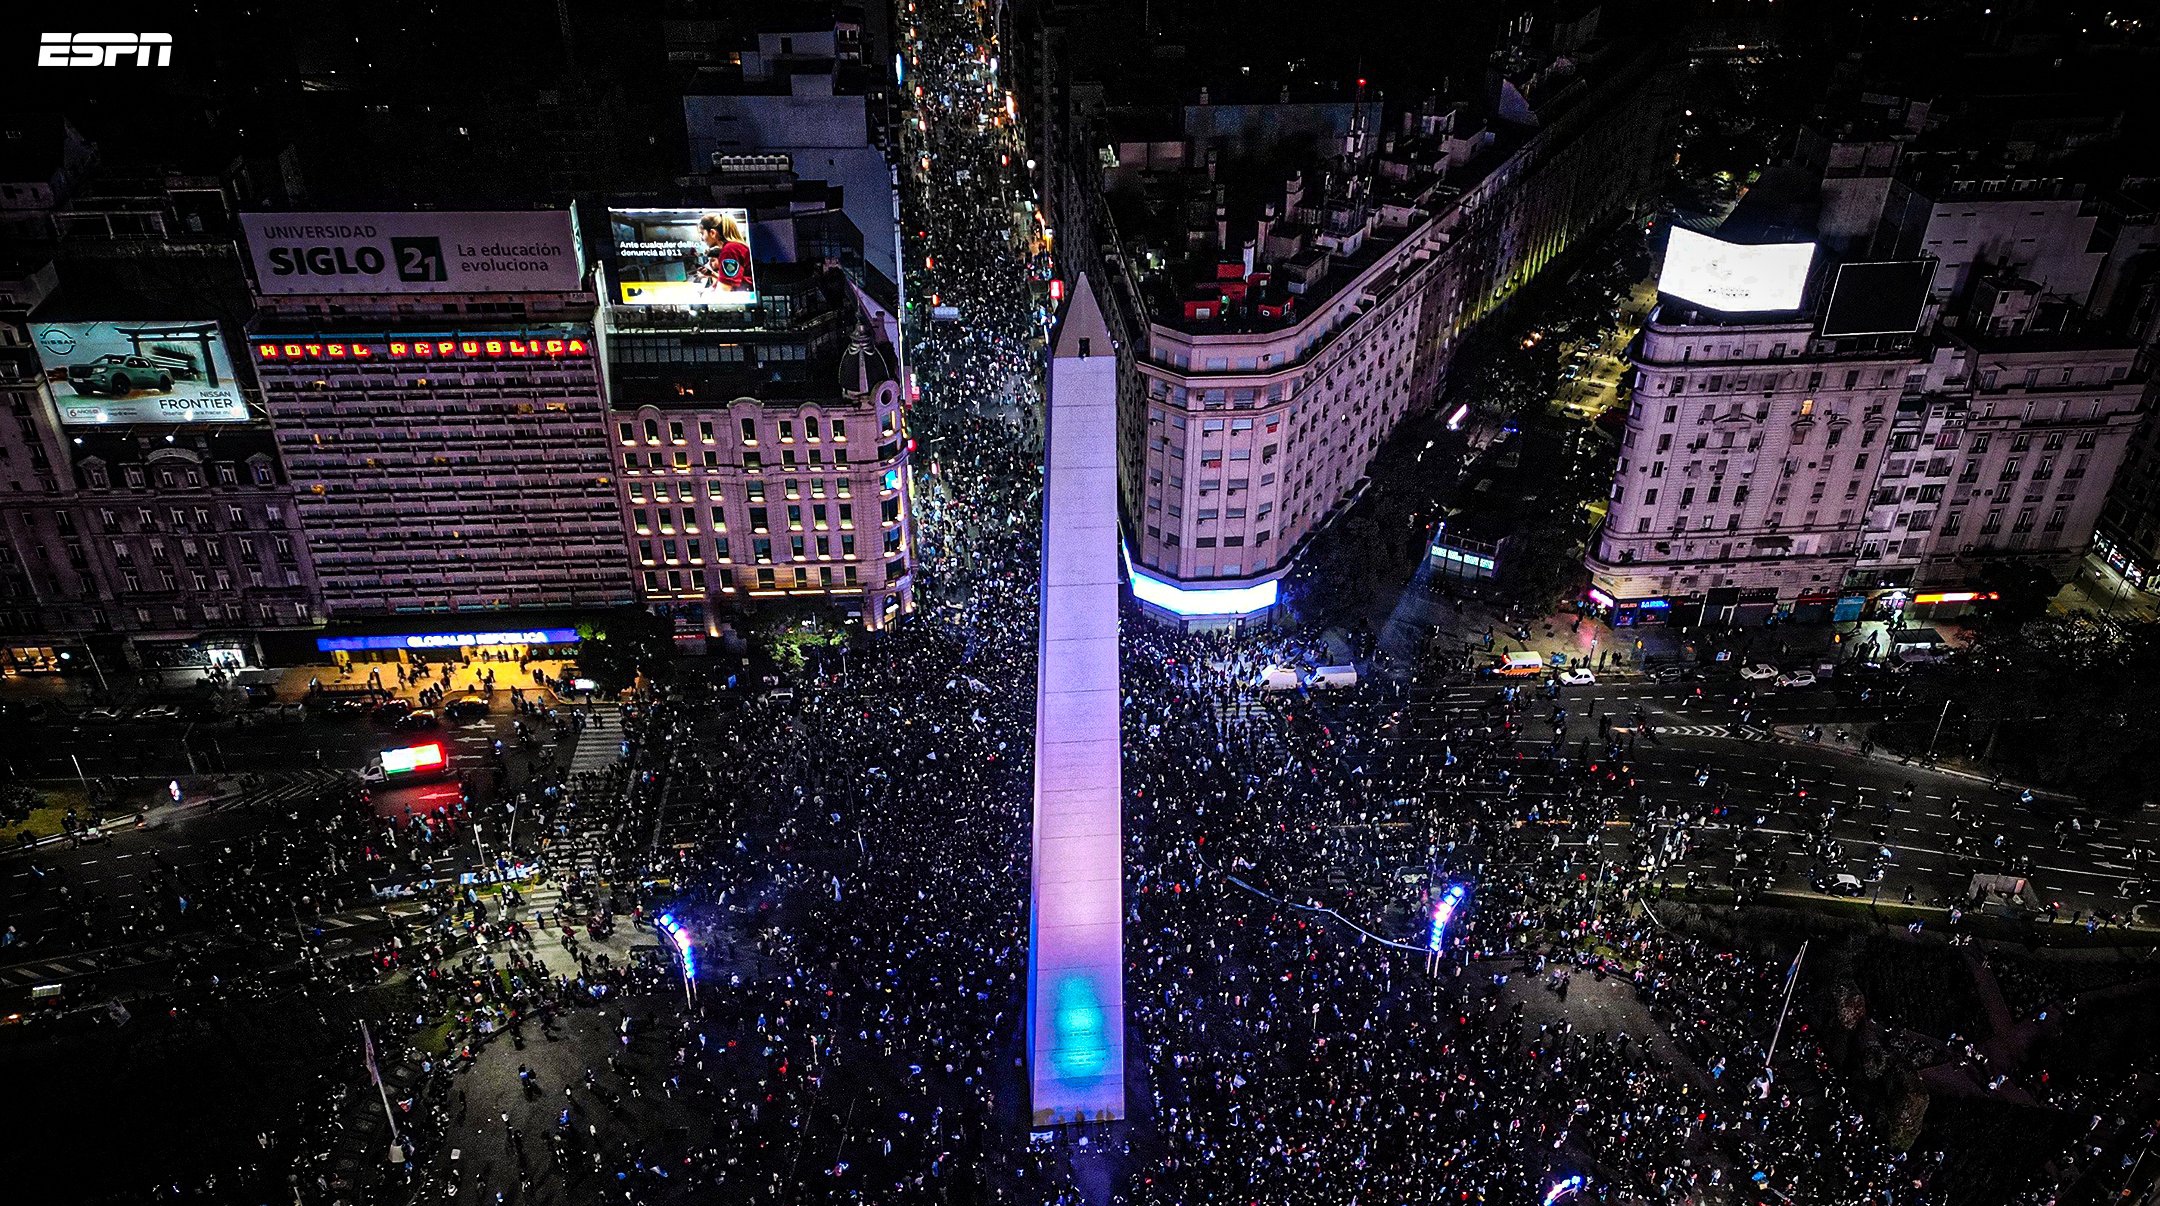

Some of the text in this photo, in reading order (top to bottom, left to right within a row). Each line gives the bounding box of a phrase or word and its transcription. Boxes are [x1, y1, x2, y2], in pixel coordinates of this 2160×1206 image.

[263, 225, 378, 240] UNIVERSIDAD
[457, 242, 561, 257] La educación
[619, 241, 639, 249] Ante
[639, 240, 676, 251] cualquier
[658, 249, 667, 257] al
[667, 249, 683, 257] 911
[269, 246, 437, 282] SIGLO 21
[461, 259, 549, 273] evoluciona
[259, 339, 586, 357] HOTEL REPUBLICA
[199, 390, 232, 398] NISSAN
[159, 398, 234, 410] FRONTIER
[69, 408, 77, 417] 6
